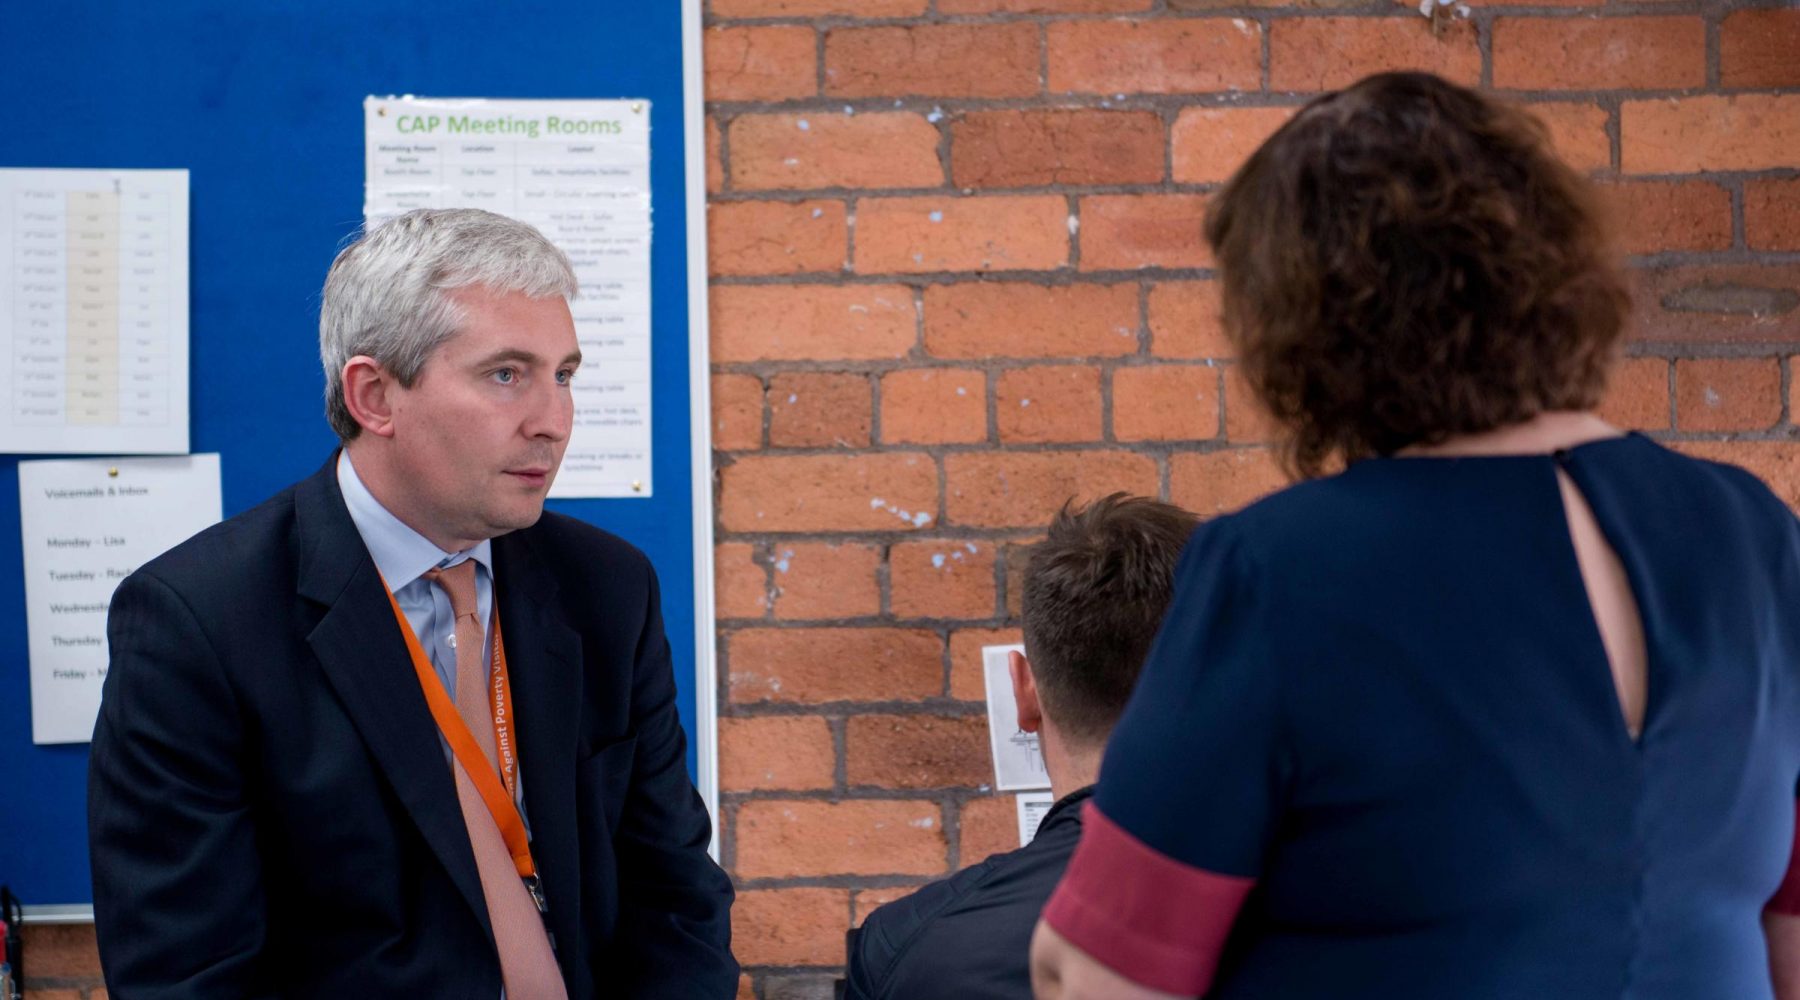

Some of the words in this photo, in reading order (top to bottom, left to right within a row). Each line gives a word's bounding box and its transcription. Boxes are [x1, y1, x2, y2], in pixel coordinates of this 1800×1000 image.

[397, 115, 440, 134] CAP
[448, 115, 540, 138] Meeting
[547, 115, 622, 134] Rooms
[45, 487, 104, 500] Voicemails
[108, 487, 115, 496] &
[119, 486, 149, 496] Inbox
[47, 537, 92, 549] Monday
[104, 536, 126, 547] Lisa
[49, 570, 96, 582] Tuesday
[50, 603, 109, 614] Wednesd
[52, 635, 102, 648] Thursday
[53, 668, 87, 681] Friday
[495, 675, 506, 724] Poverty
[499, 725, 514, 773] Against
